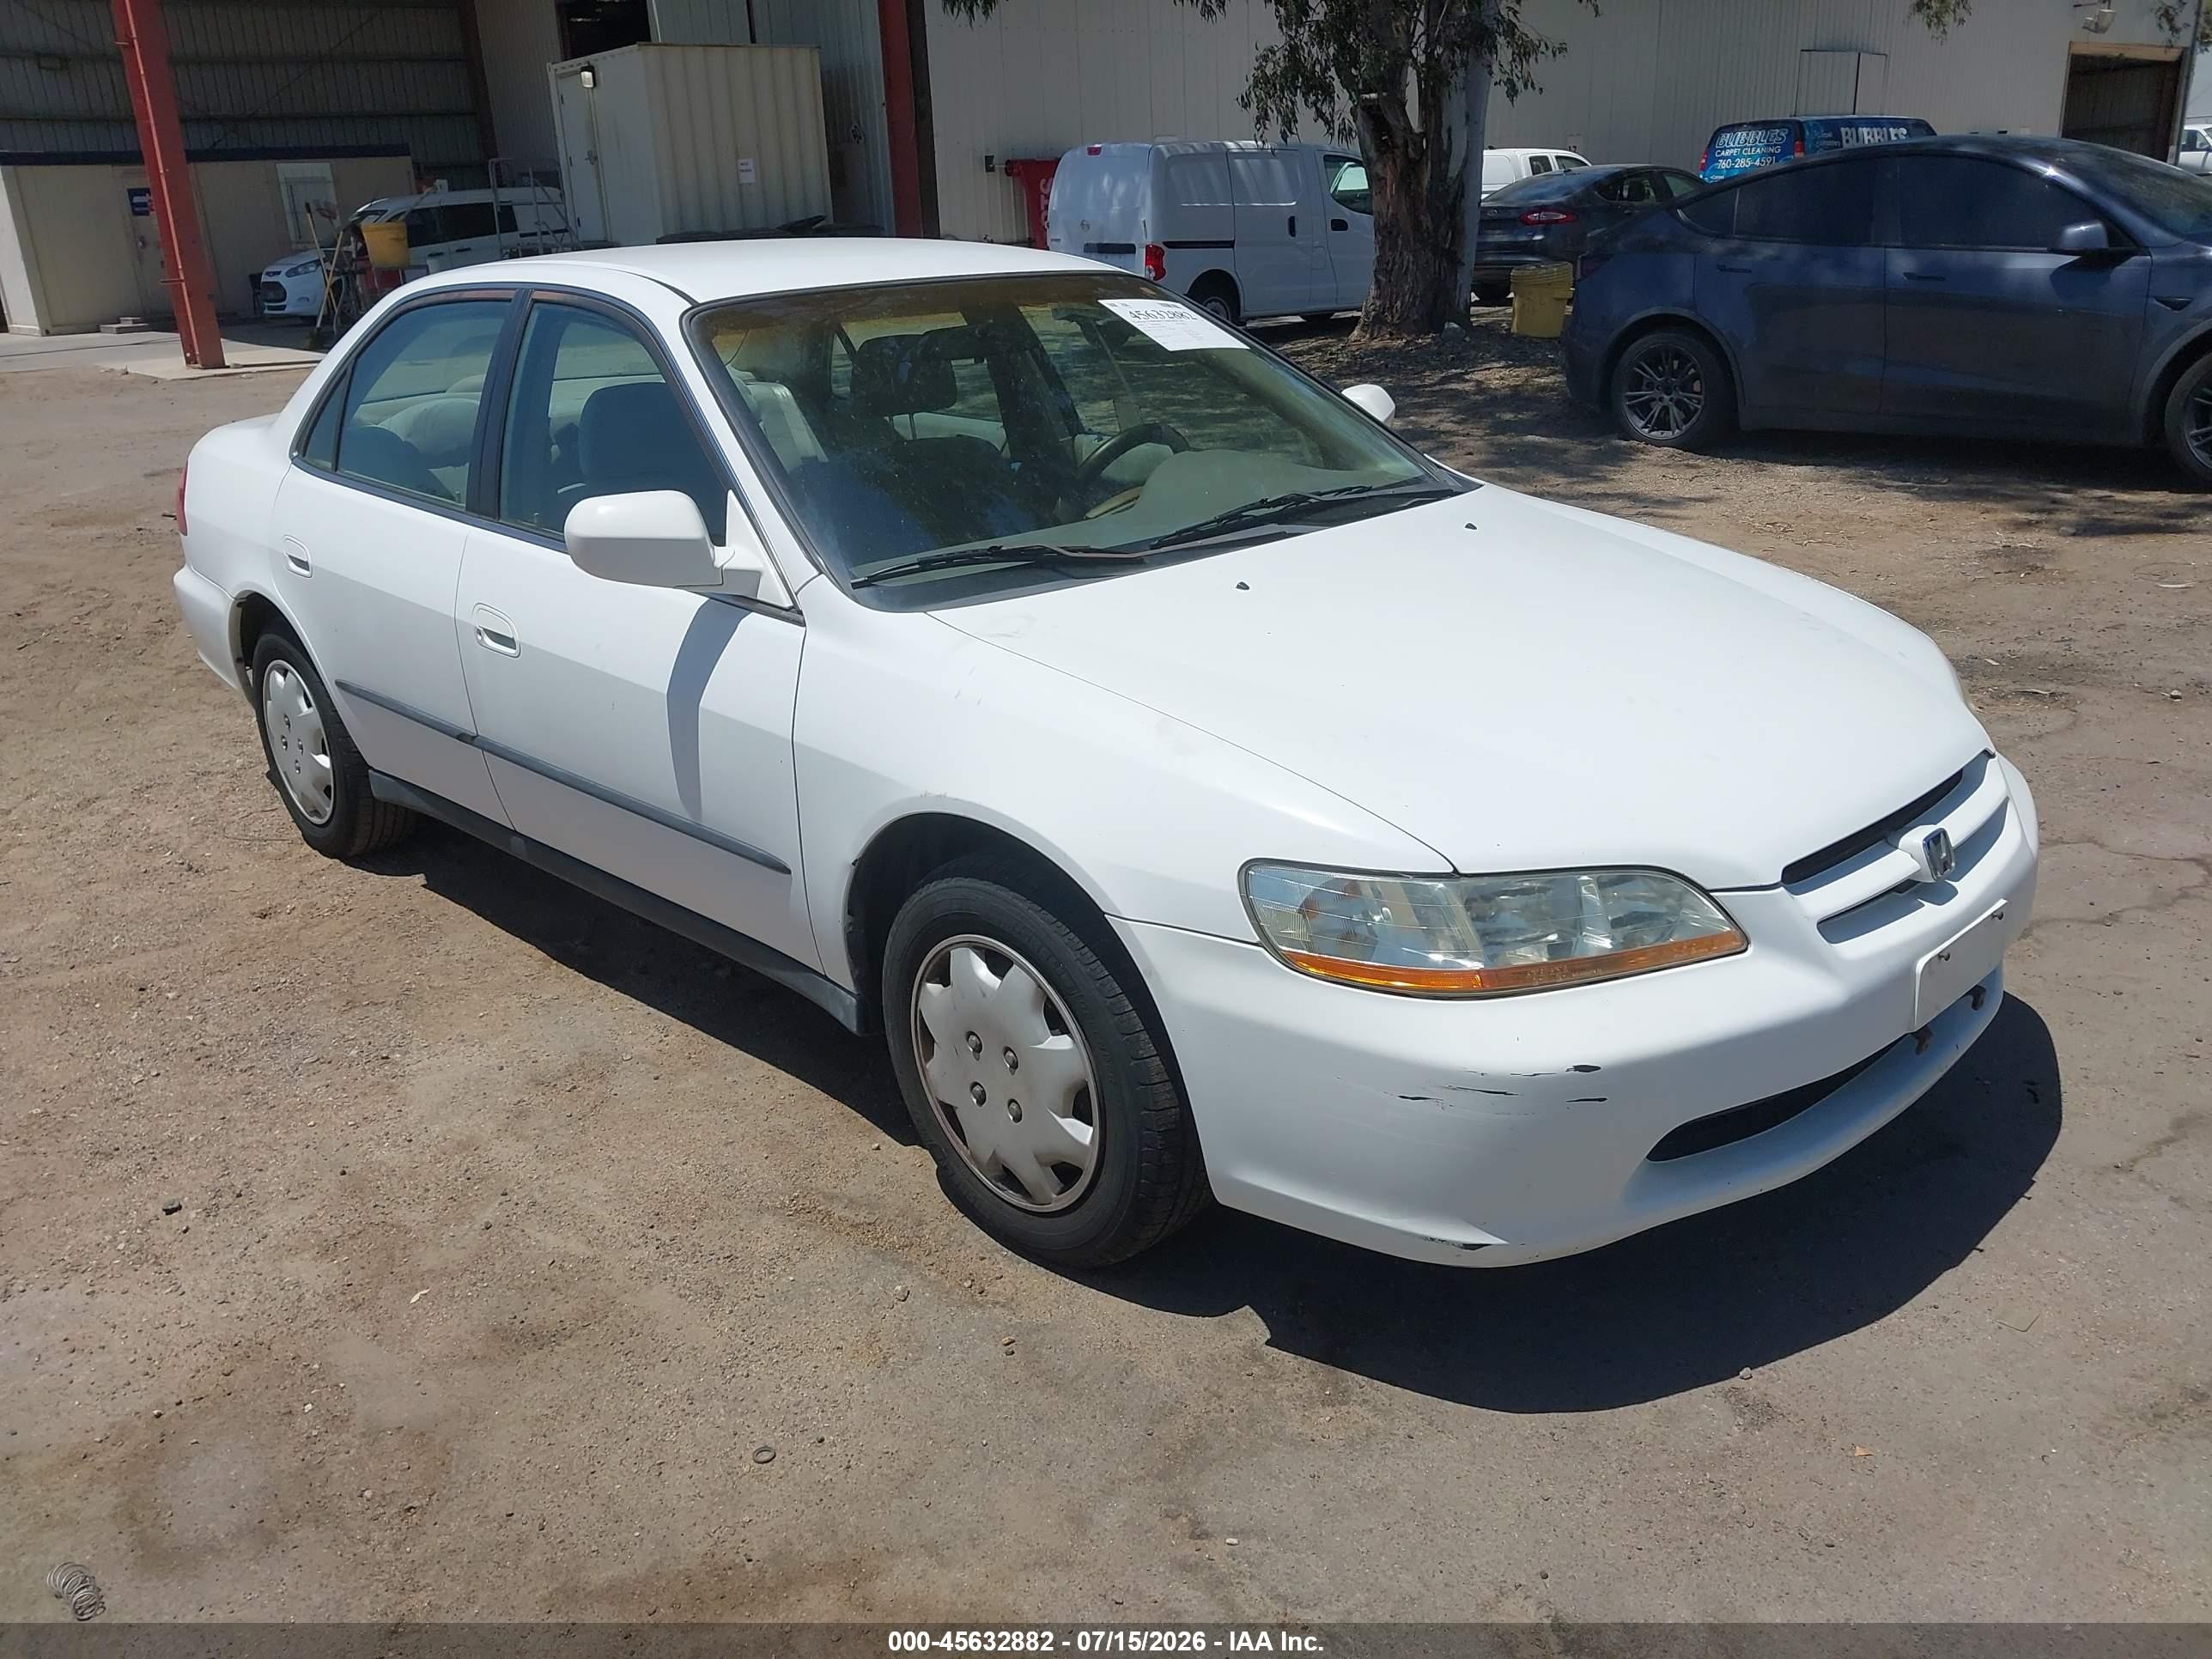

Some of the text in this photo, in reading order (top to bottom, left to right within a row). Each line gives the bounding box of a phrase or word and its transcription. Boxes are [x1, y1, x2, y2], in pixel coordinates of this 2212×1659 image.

[1716, 129, 1789, 148] BUBBLES
[1716, 146, 1781, 157] CARPET CLEANING
[1717, 156, 1776, 169] 760-285-4591
